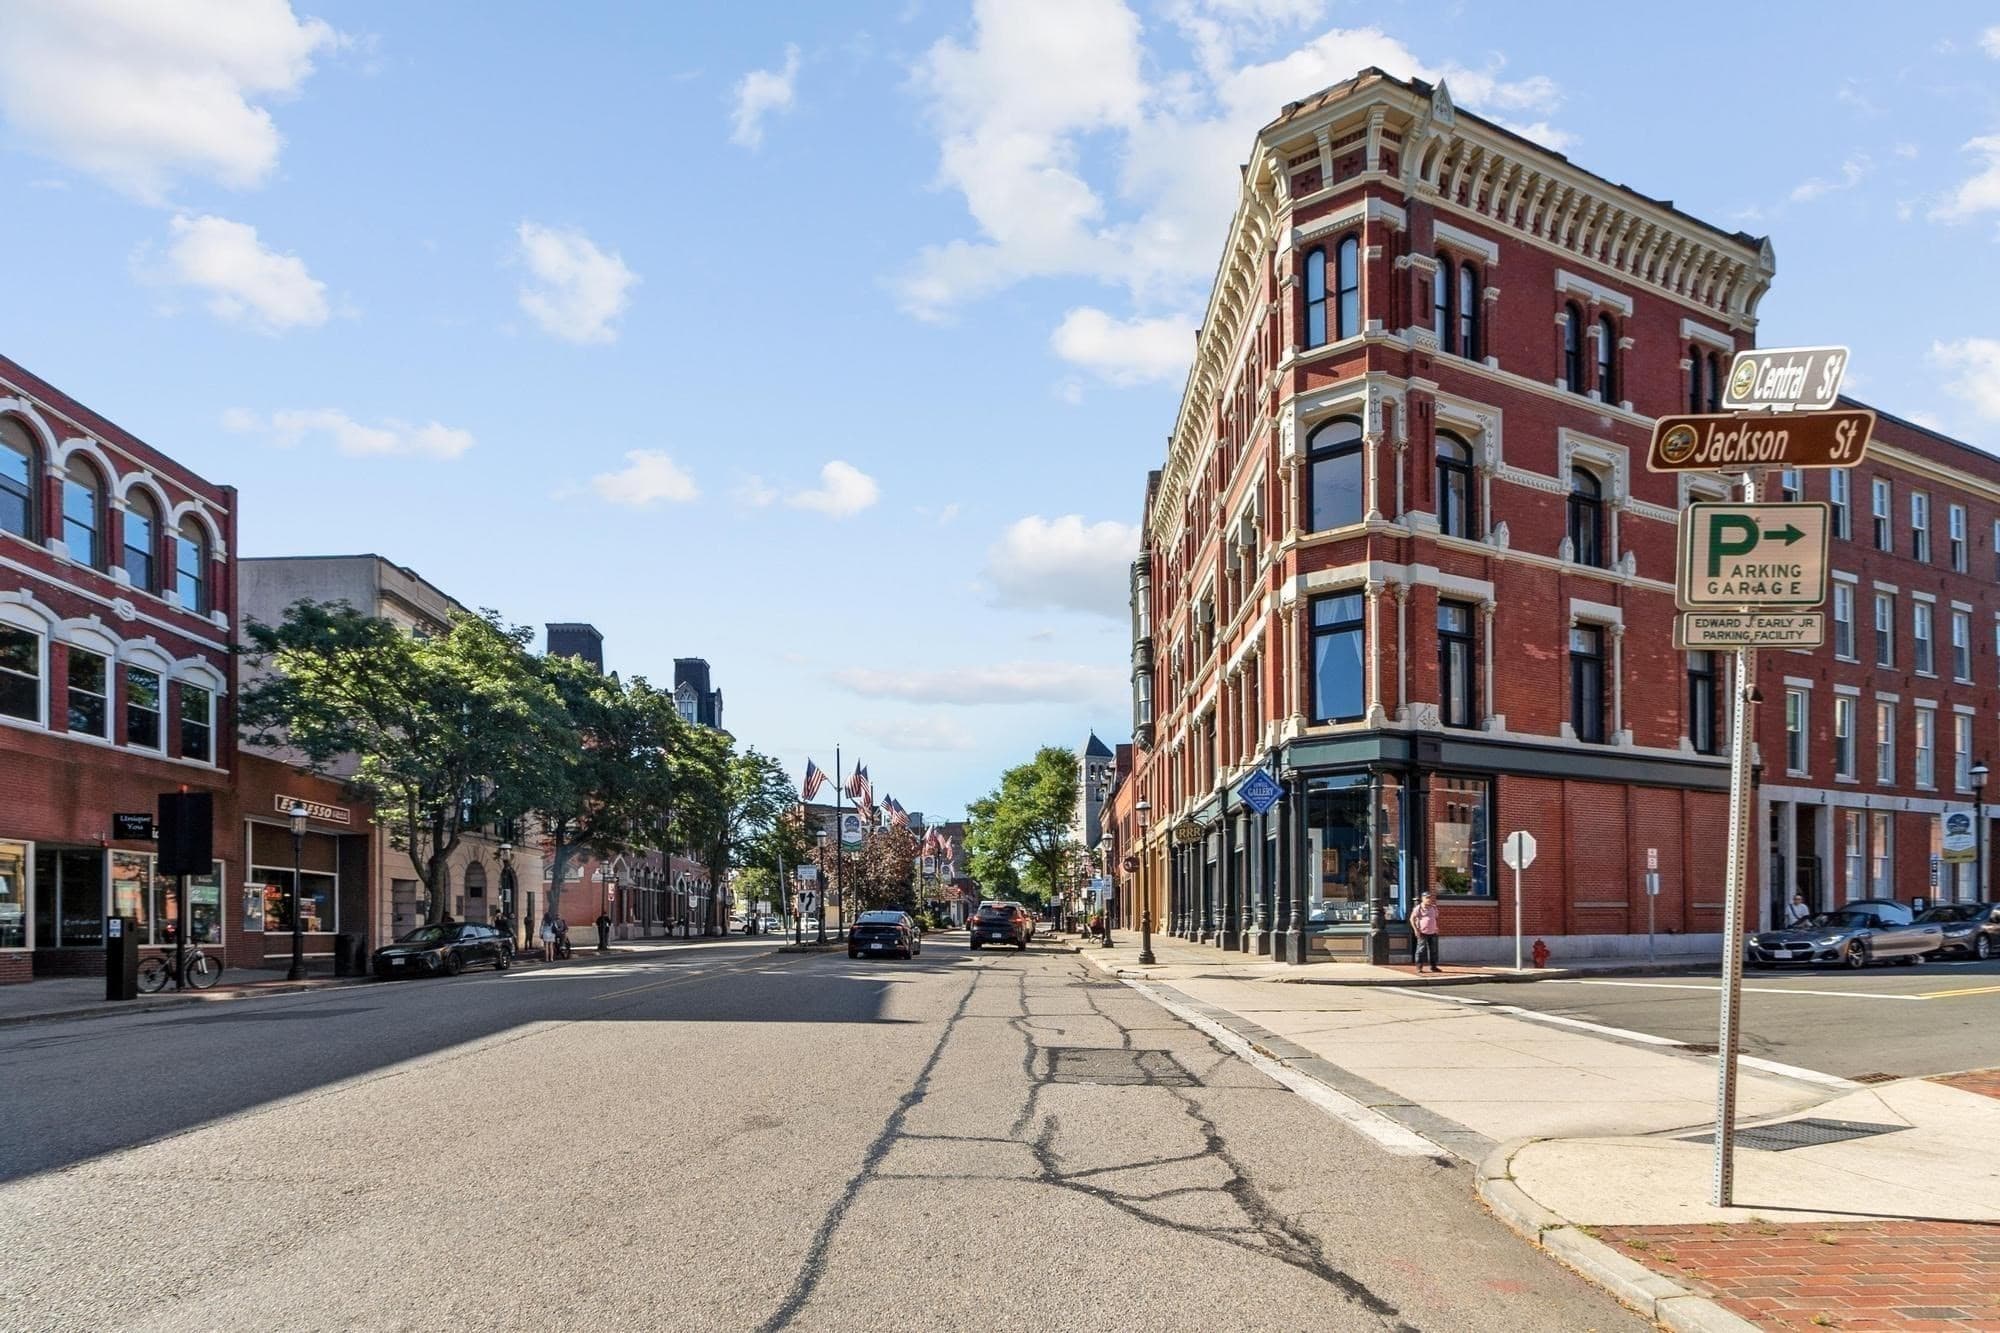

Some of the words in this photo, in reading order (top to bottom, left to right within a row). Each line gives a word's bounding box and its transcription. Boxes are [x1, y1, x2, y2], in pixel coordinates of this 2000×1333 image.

[1753, 356, 1813, 399] Central
[1816, 355, 1842, 399] St
[1695, 421, 1789, 462] Jackson
[1830, 419, 1857, 459] St
[1707, 582, 1801, 594] GARAGE
[1695, 619, 1741, 628] EDWARD
[1757, 619, 1794, 627] EARLY
[1703, 631, 1750, 640] PARKING
[1754, 631, 1804, 640] FACILITY
[1247, 787, 1274, 796] GALLERY
